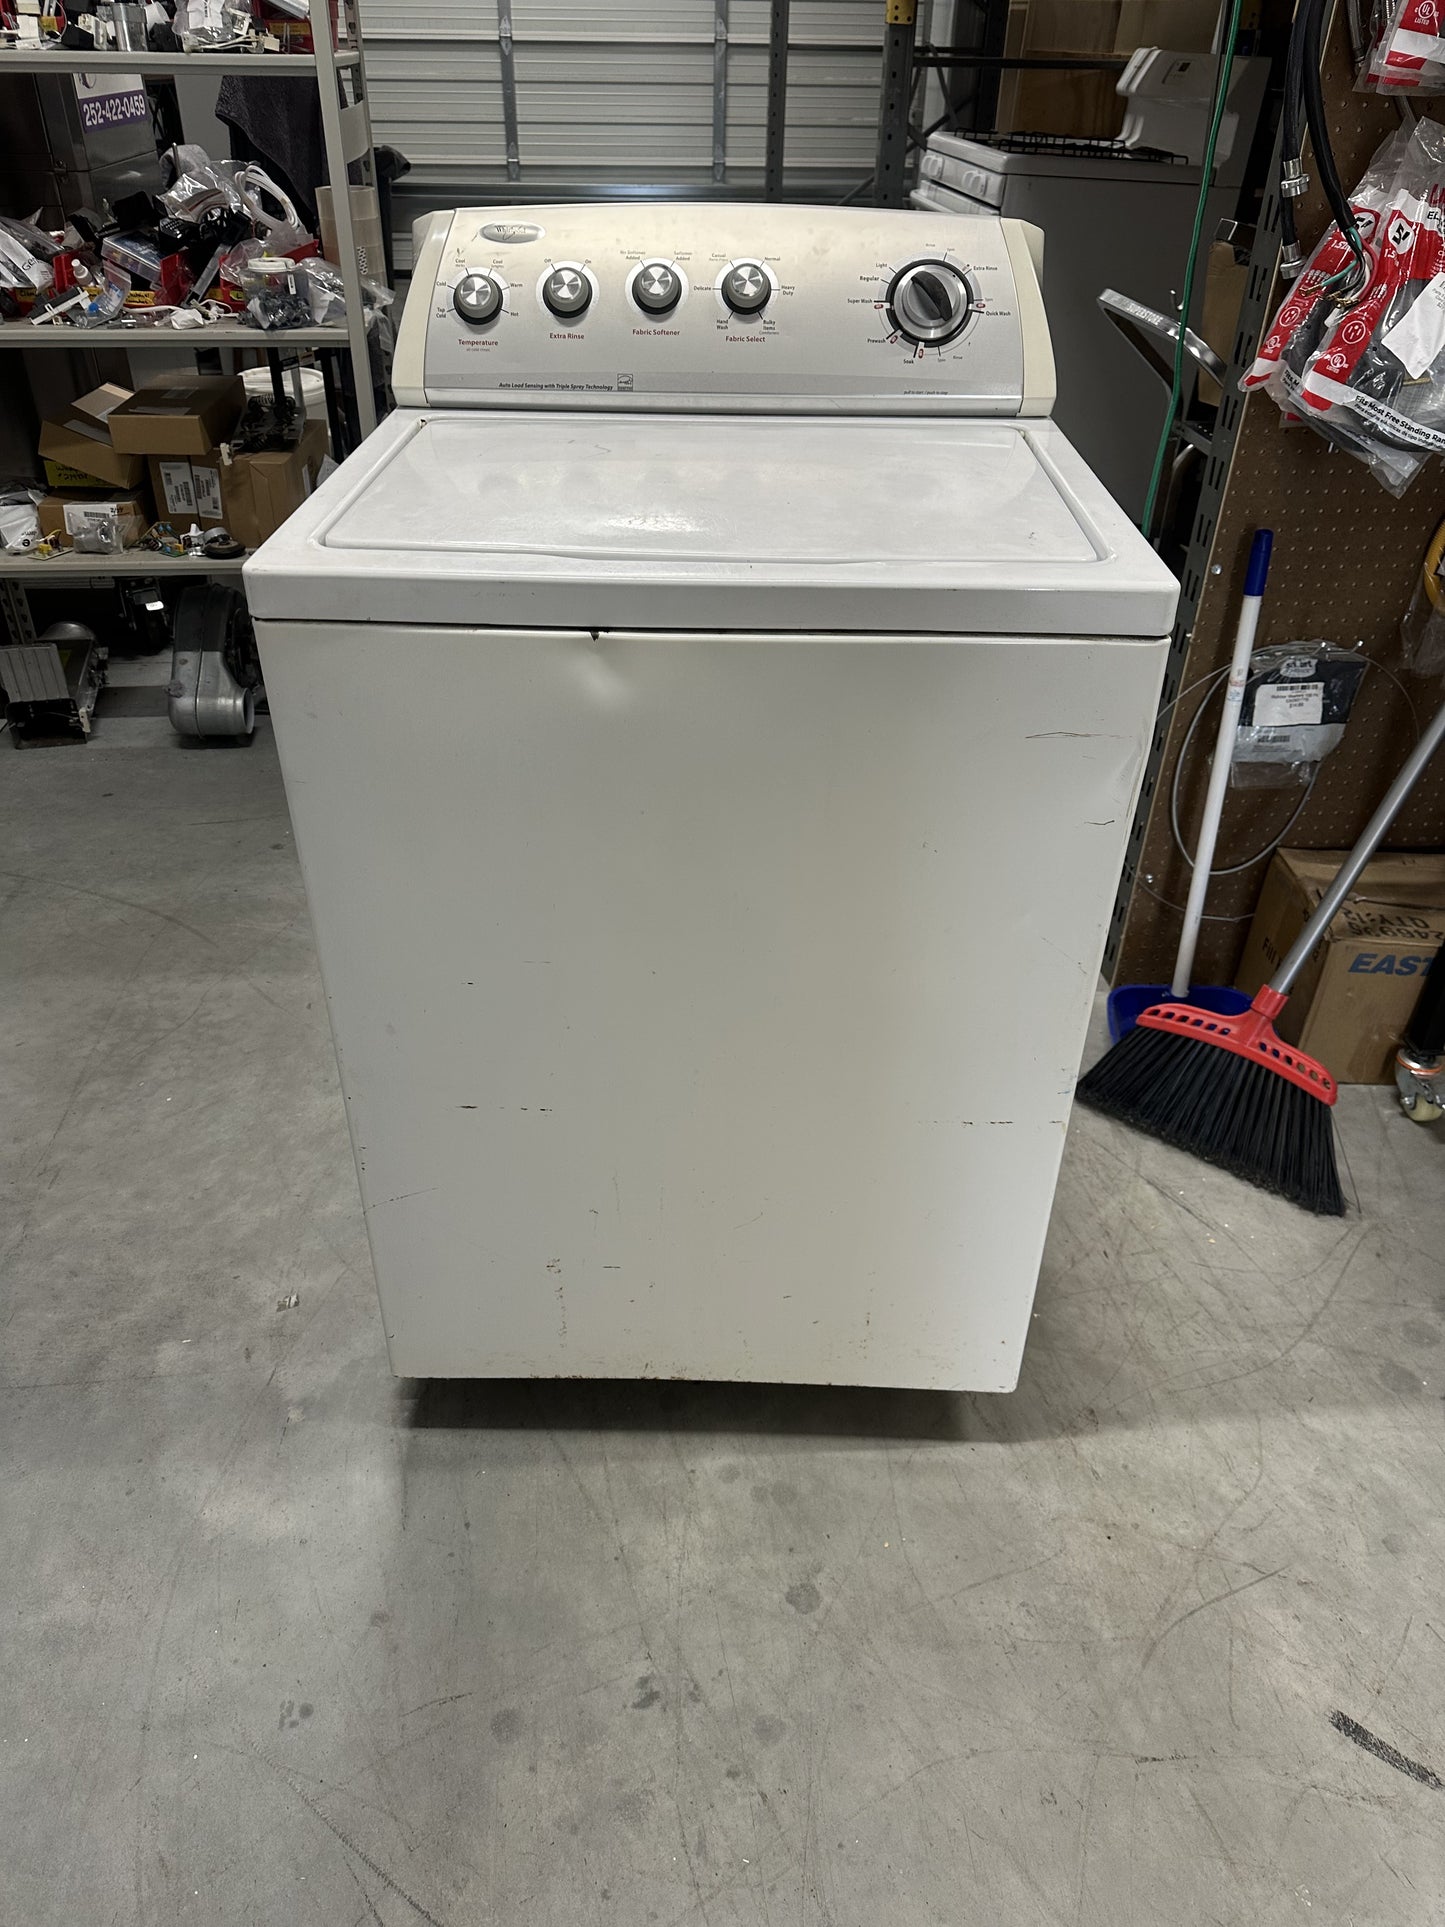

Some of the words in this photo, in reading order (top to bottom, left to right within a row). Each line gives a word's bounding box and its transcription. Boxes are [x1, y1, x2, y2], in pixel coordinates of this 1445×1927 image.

[1414, 17, 1430, 26] LISTED
[83, 94, 146, 127] 252-422-0459
[549, 332, 567, 340] Extra
[632, 328, 652, 336] Fabric
[653, 328, 681, 336] Softener
[458, 339, 499, 347] Temperature
[725, 335, 745, 343] Fabric
[746, 335, 766, 343] Select
[1355, 395, 1369, 406] Fits
[1368, 402, 1385, 416] Most
[1384, 411, 1400, 425] Free
[1399, 420, 1431, 440] Standing
